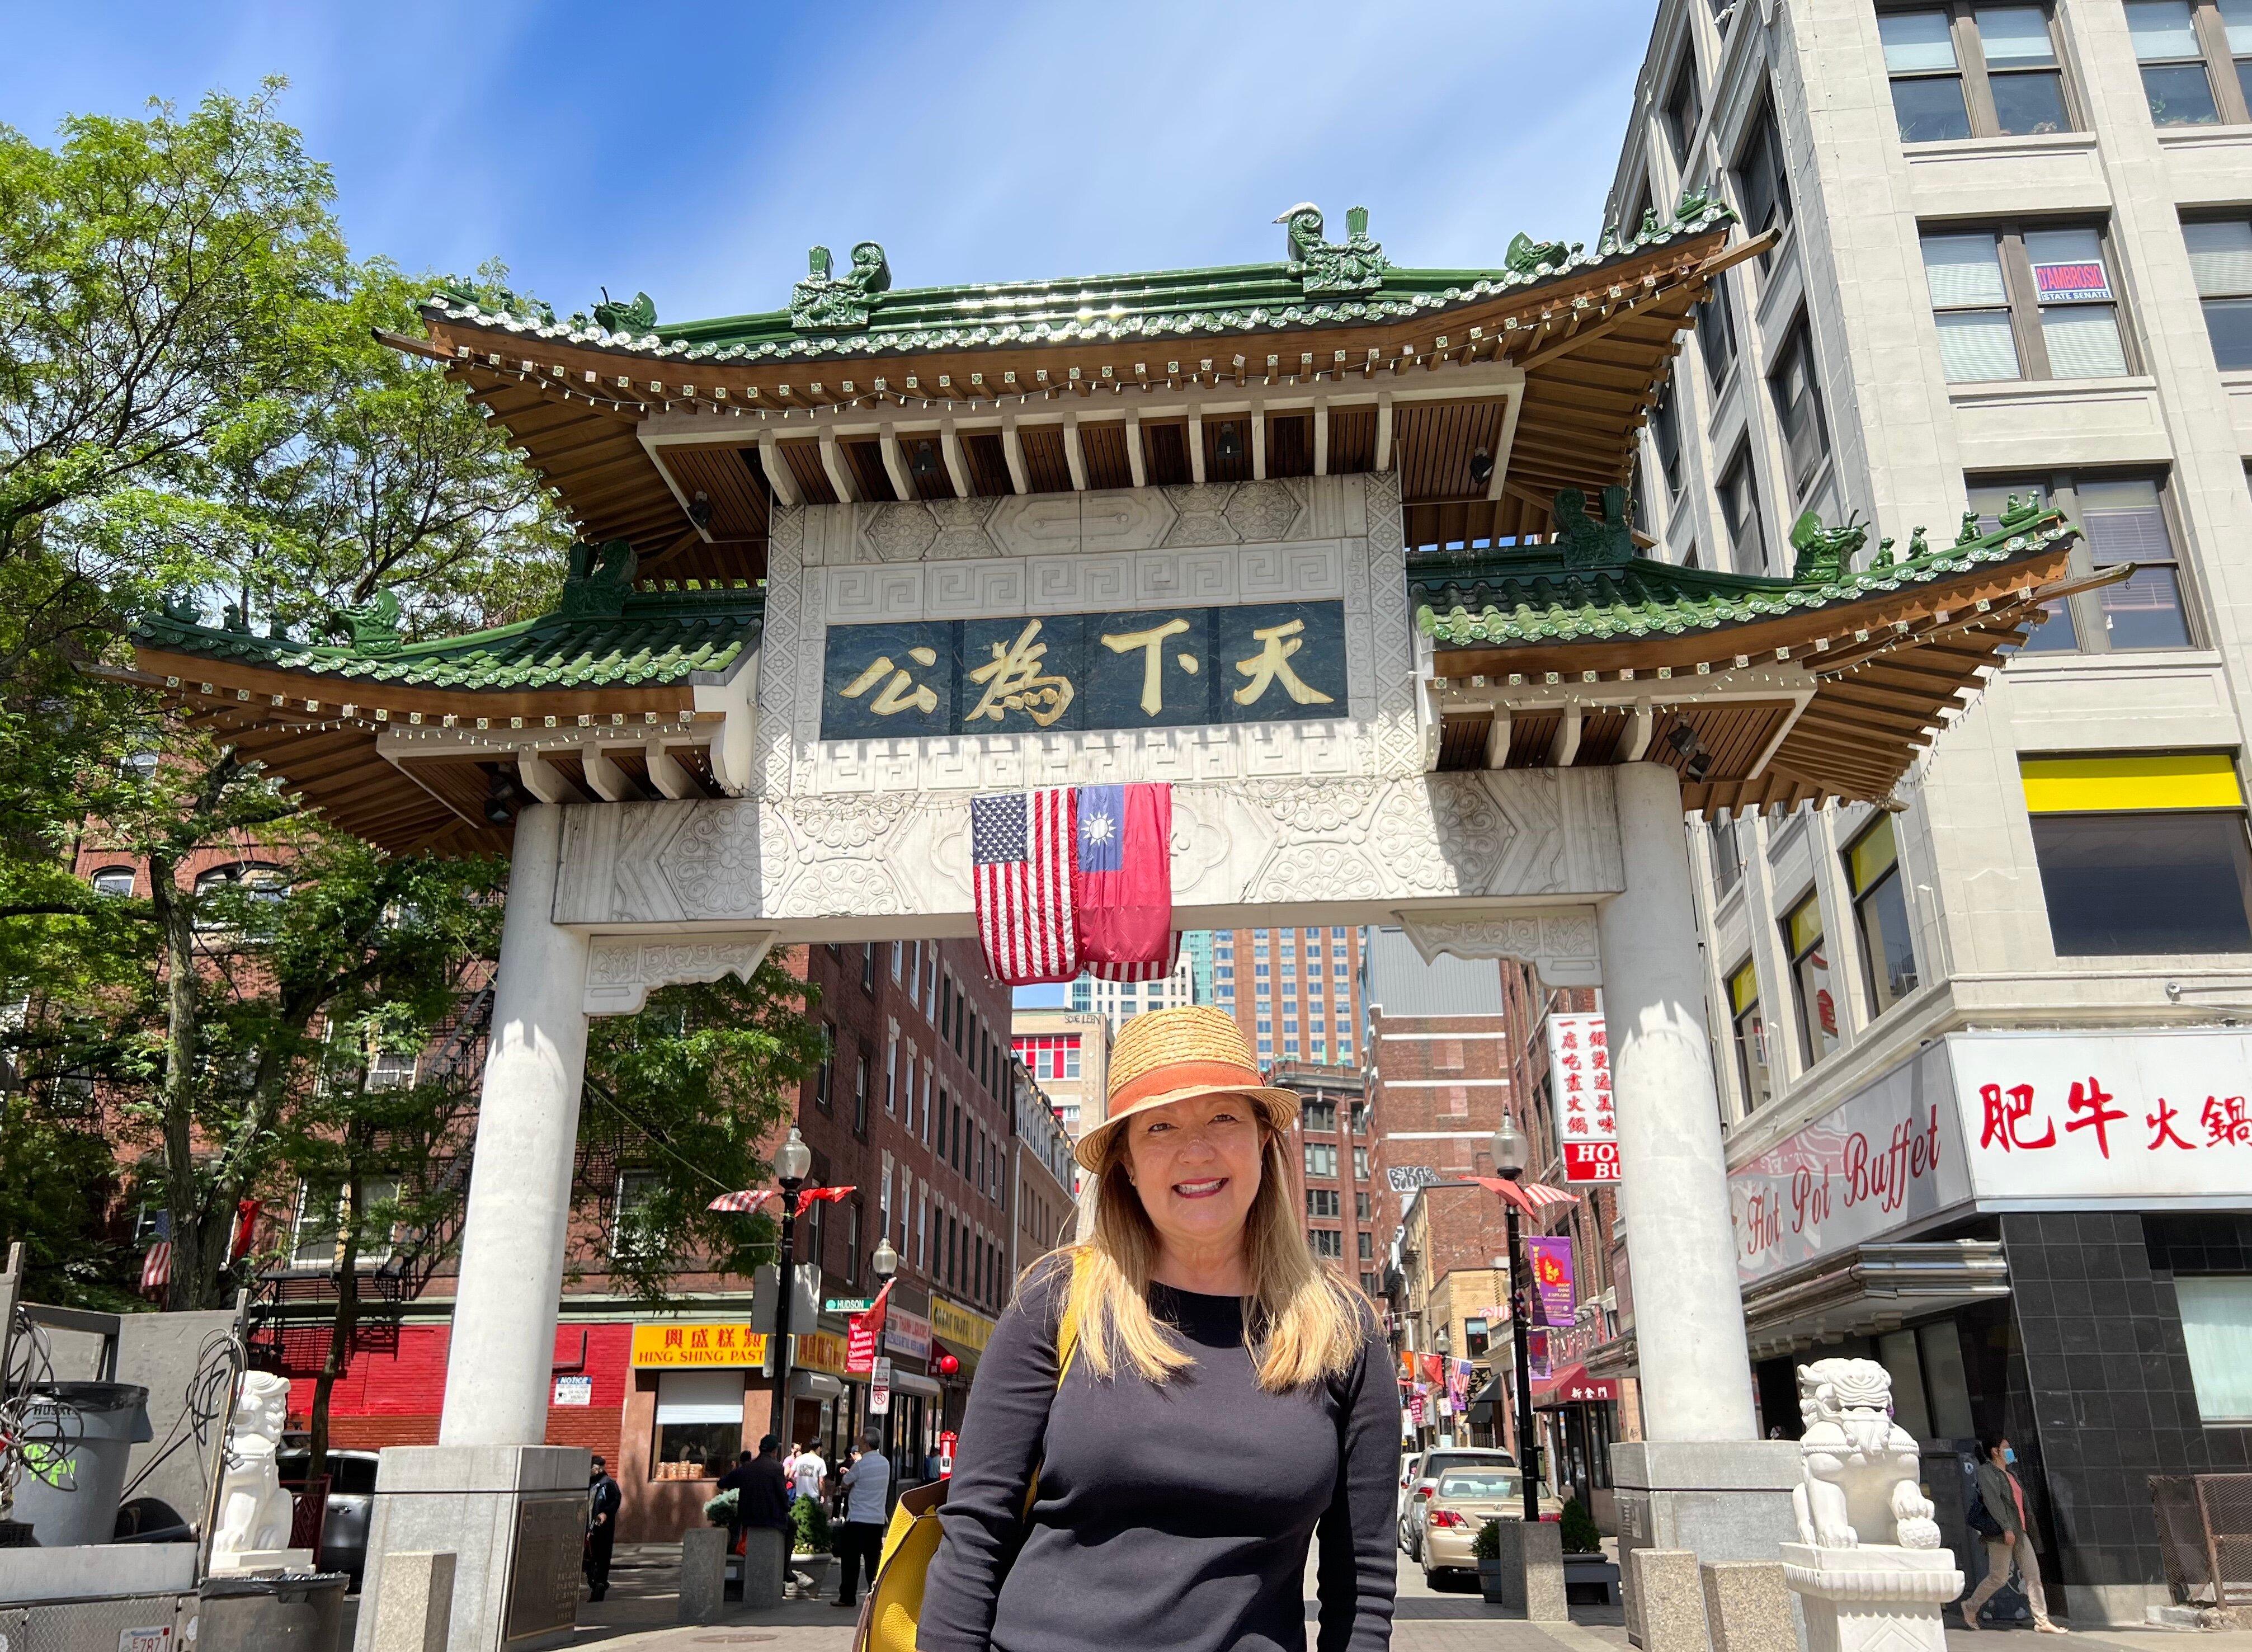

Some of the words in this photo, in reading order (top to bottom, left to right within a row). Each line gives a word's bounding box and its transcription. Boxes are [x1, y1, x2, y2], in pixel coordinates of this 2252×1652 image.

[2037, 265, 2105, 290] D'AMBROSIO
[2043, 292, 2072, 300] STATE
[2073, 291, 2108, 299] SENATE
[1577, 1144, 1618, 1162] HO
[1747, 1187, 1781, 1254] Hot
[1792, 1164, 1831, 1233] Pot
[1844, 1104, 1941, 1213] Buffet
[837, 1300, 864, 1310] HUDSON
[639, 1351, 673, 1362] HING
[680, 1350, 724, 1362] SHING
